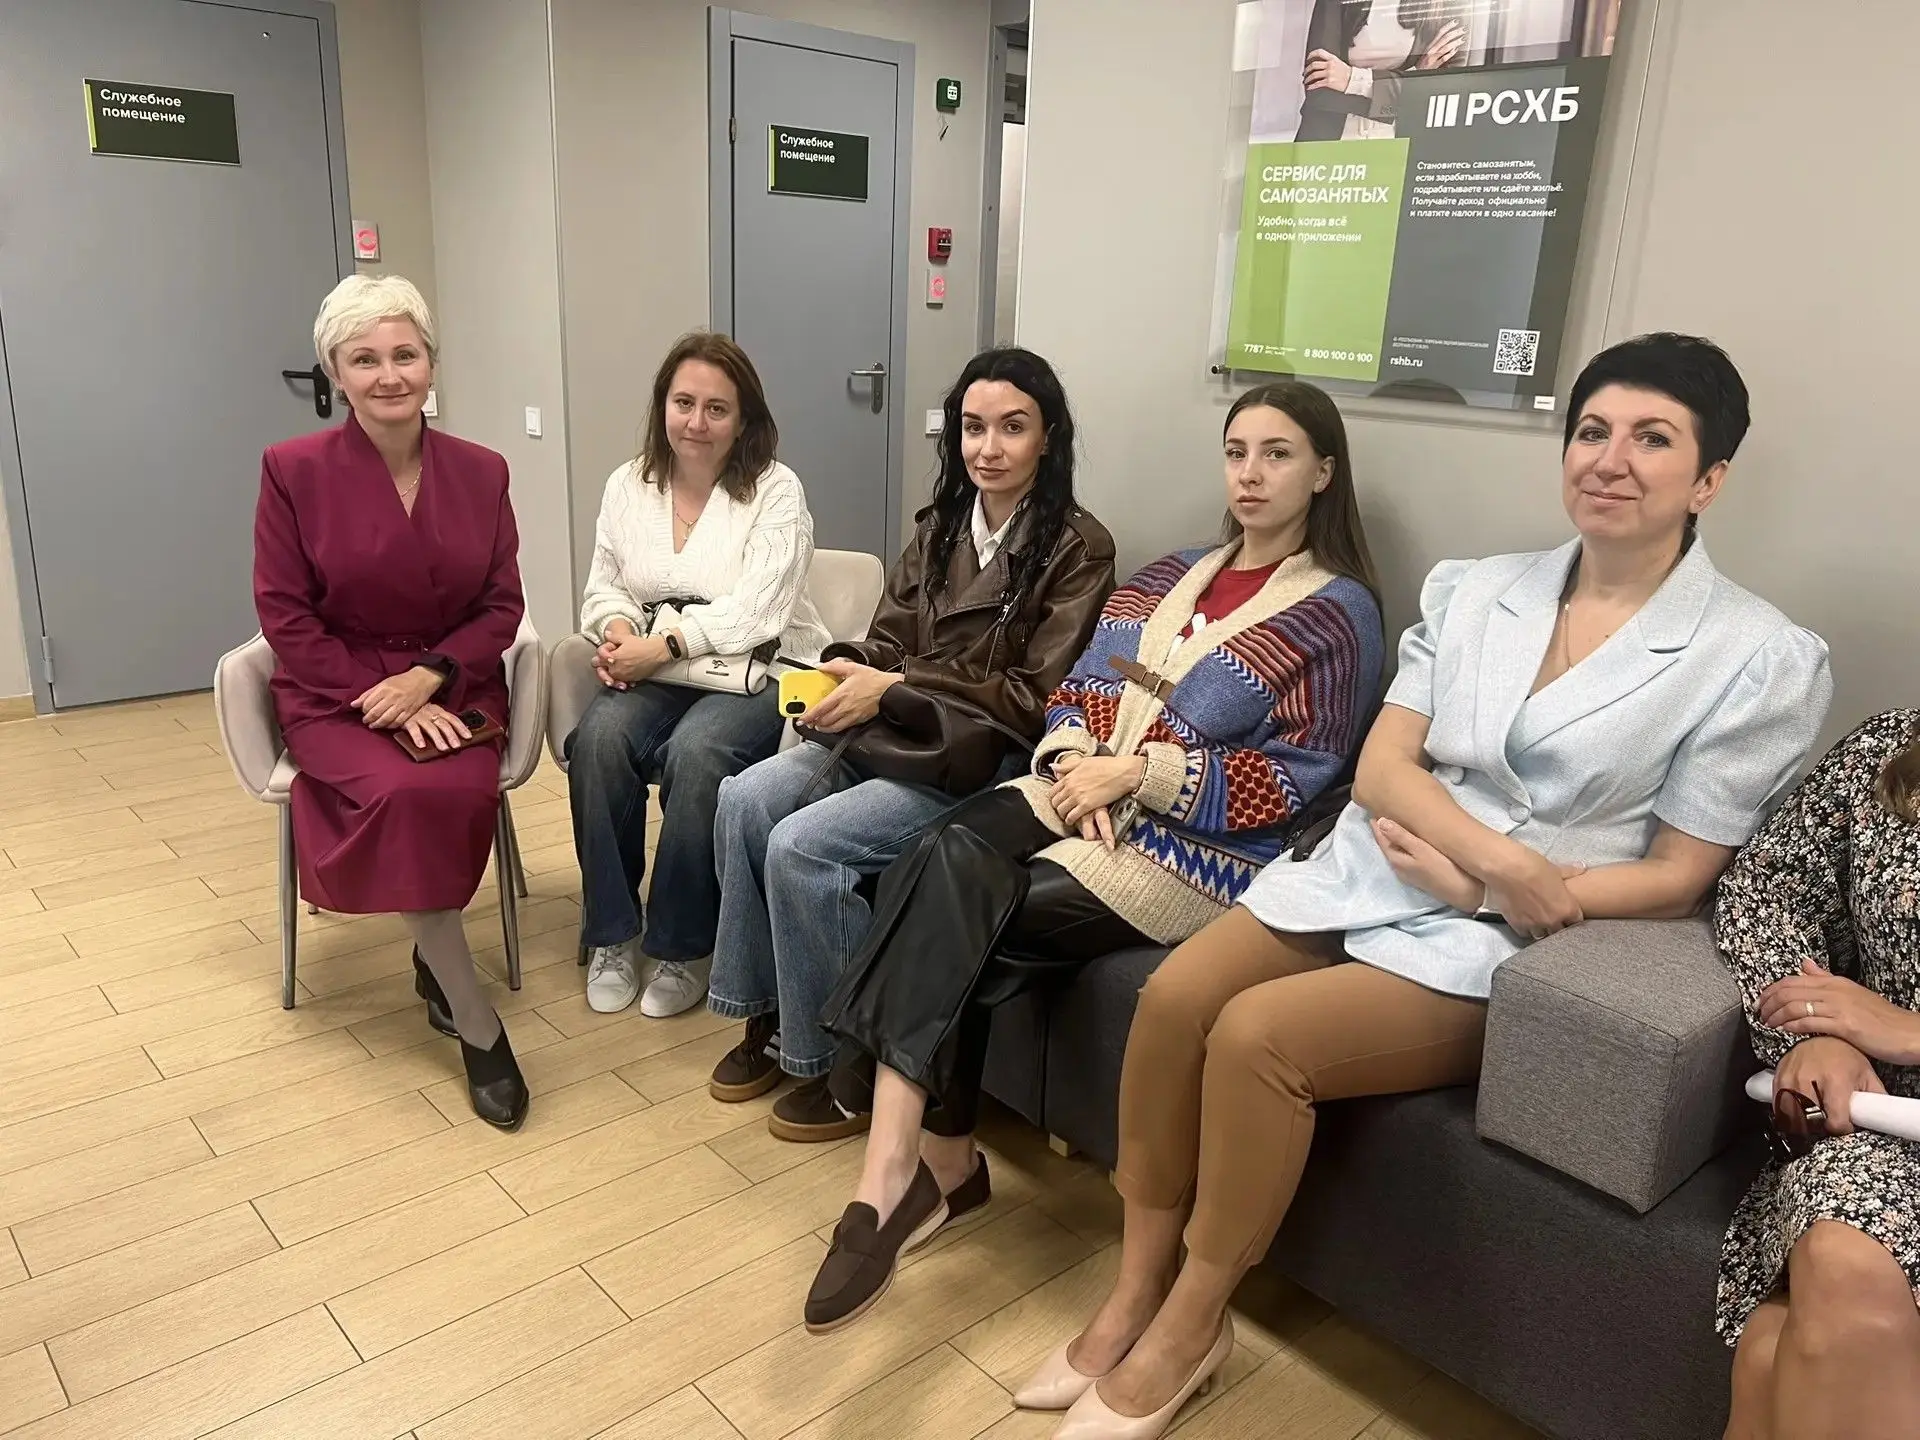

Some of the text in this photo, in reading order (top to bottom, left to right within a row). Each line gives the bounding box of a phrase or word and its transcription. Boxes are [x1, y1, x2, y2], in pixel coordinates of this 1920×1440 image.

[100, 88, 182, 107] Служебное
[1465, 86, 1580, 126] РСХБ
[102, 107, 186, 123] помещение
[780, 133, 834, 149] Служебное
[780, 149, 836, 164] помещение
[1417, 160, 1536, 170] Становитесь самозанятым,
[1262, 164, 1367, 183] СЕРВИС ДЛЯ
[1415, 174, 1435, 182] если
[1436, 172, 1500, 183] зарабатываете
[1513, 171, 1542, 181] хобби,
[1259, 186, 1390, 204] САМОЗАНЯТЫХ
[1413, 182, 1564, 196] подрабатываете или сдаёте жильё.
[1411, 196, 1547, 208] Получайте доход официально
[1417, 210, 1451, 218] платите
[1452, 210, 1483, 218] налоги
[1484, 210, 1490, 218] в
[1491, 210, 1515, 219] одно
[1516, 208, 1557, 218] касание!
[1257, 215, 1348, 228] Удобно, когда всё
[1256, 231, 1362, 243] в одном приложении
[1244, 343, 1264, 354] 7787
[1304, 348, 1311, 358] 8
[1311, 349, 1330, 359] 800
[1331, 350, 1347, 361] 100
[1348, 352, 1355, 361] 0
[1356, 352, 1373, 363] 100
[1390, 355, 1424, 368] rshb.ru
